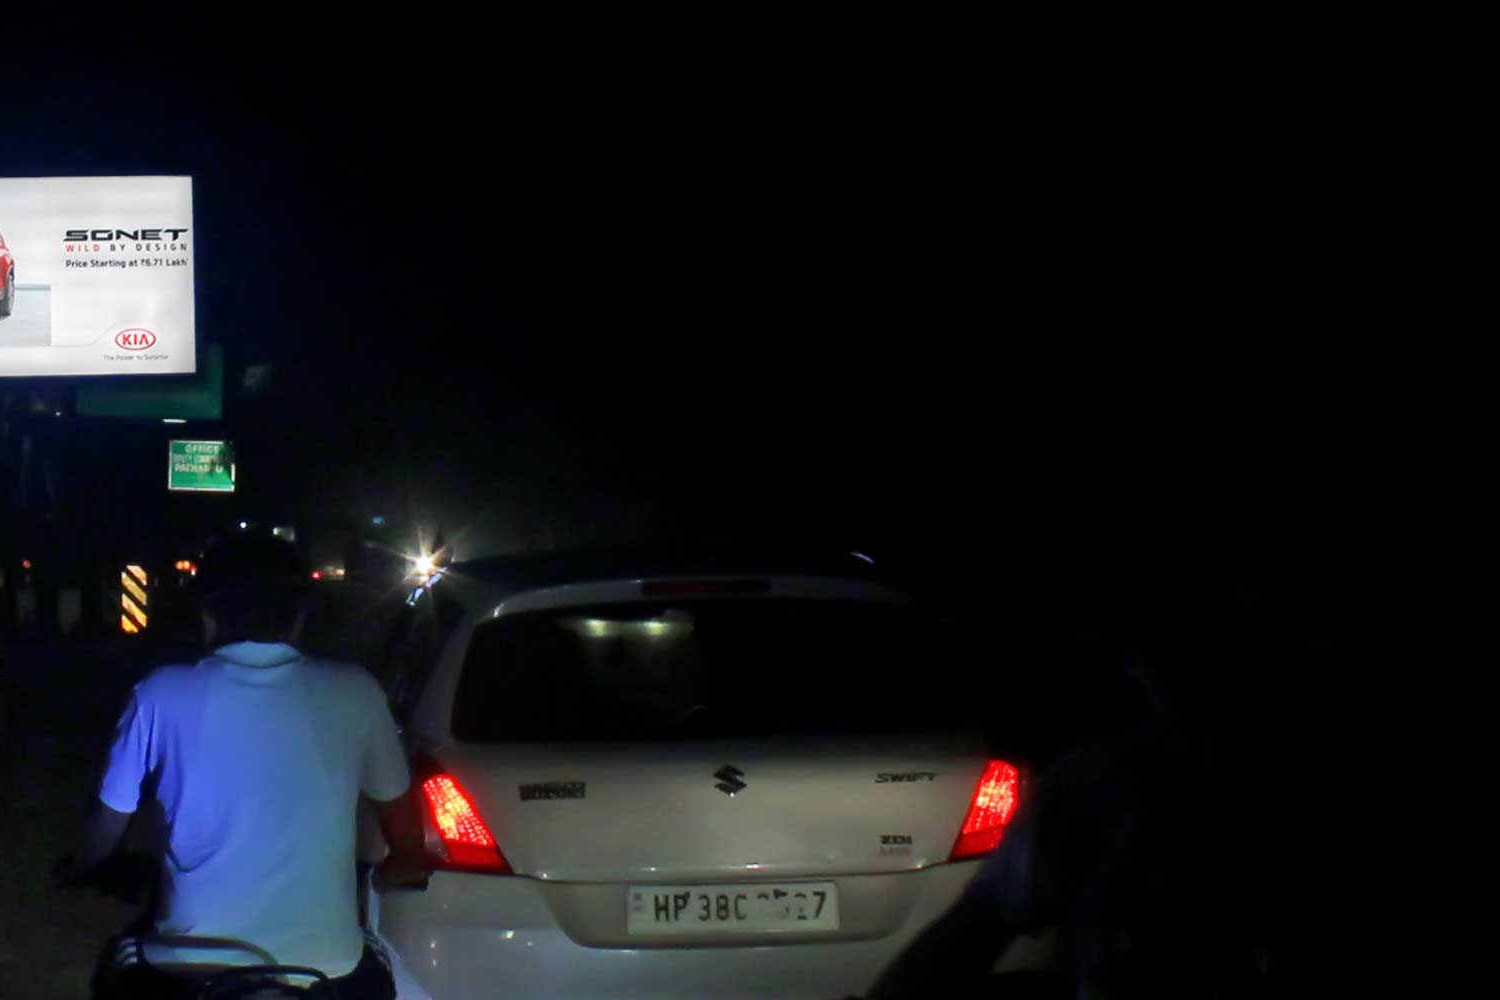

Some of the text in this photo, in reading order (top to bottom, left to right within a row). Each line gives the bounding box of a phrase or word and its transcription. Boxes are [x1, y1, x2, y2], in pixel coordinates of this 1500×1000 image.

[63, 229, 188, 241] SONET
[66, 243, 187, 252] WILD BY DESIGN
[66, 259, 88, 268] Price
[90, 259, 126, 268] Starting
[128, 259, 138, 267] at
[122, 333, 149, 345] KIA
[654, 893, 690, 922] HP
[697, 893, 747, 921] 38C
